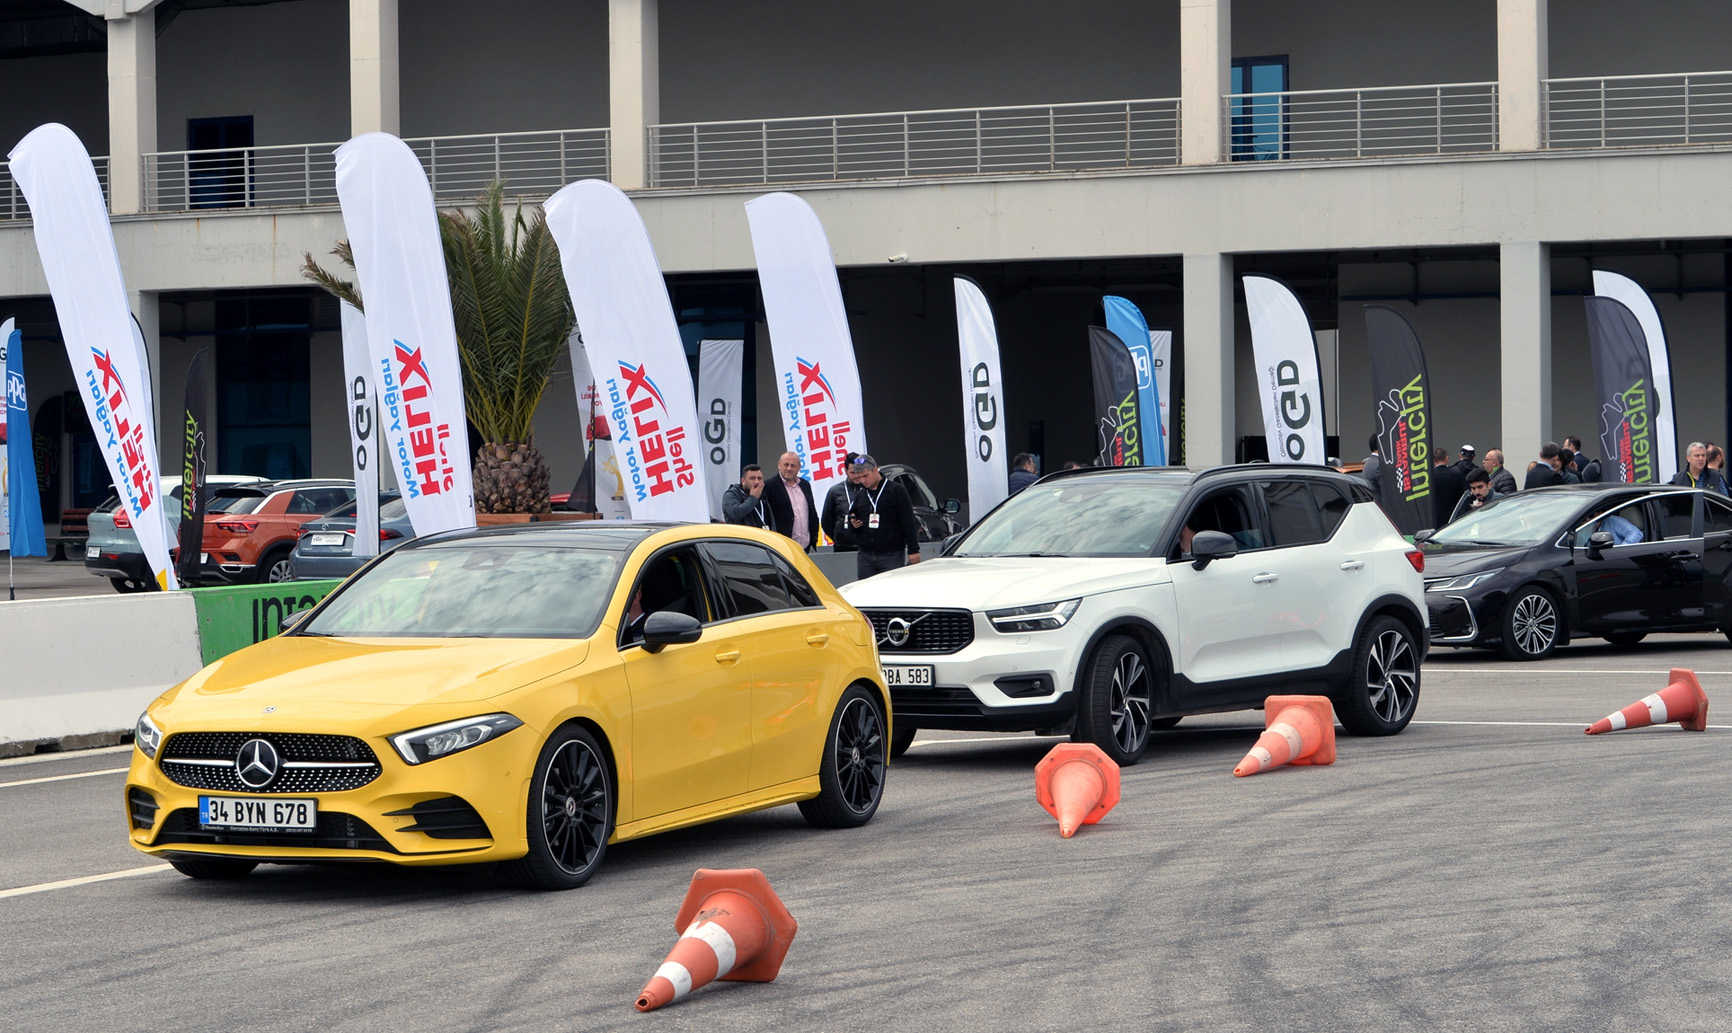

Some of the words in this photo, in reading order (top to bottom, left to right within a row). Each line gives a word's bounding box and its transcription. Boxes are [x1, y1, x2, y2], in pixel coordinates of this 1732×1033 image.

[7, 376, 26, 404] PPG
[908, 668, 929, 684] 583
[209, 800, 229, 822] 34
[234, 801, 266, 824] BYN
[273, 802, 307, 825] 678
